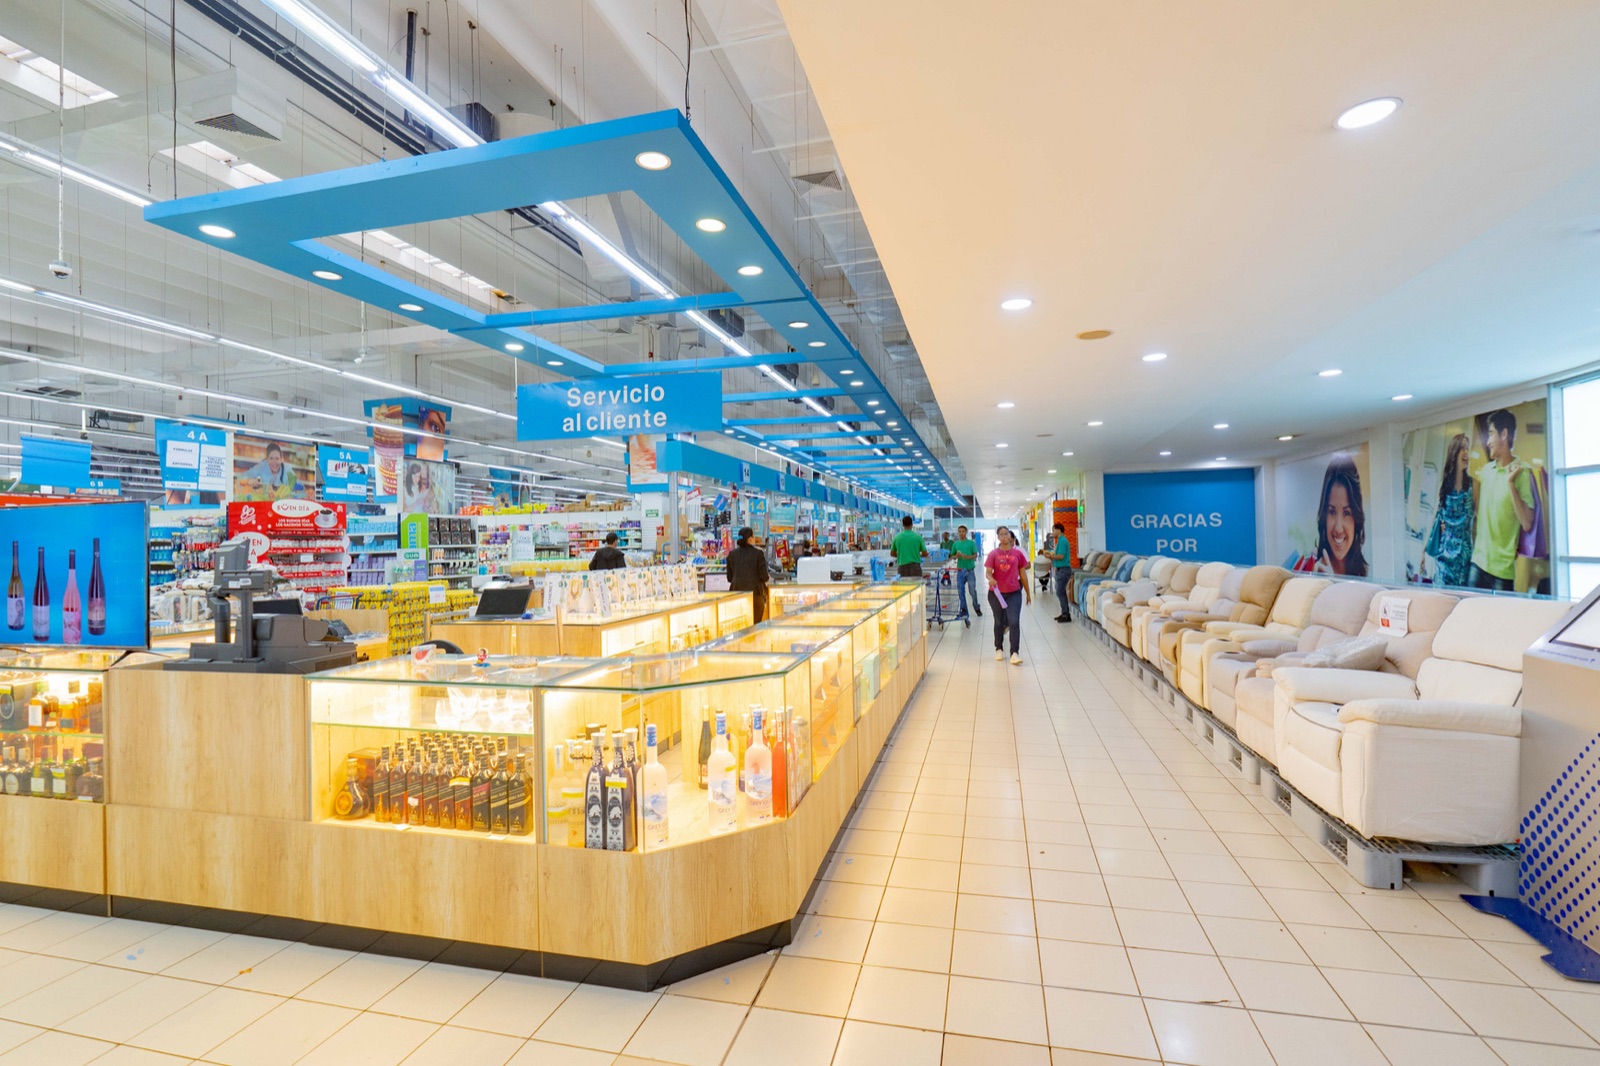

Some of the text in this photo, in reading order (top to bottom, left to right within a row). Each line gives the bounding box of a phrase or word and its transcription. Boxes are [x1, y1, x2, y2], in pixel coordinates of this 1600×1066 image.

[566, 384, 665, 408] Servicio
[562, 409, 667, 432] al cliente
[187, 430, 208, 441] 4 A
[345, 453, 352, 461] A
[743, 466, 750, 478] 14
[750, 500, 765, 510] 14
[812, 510, 824, 519] 12
[1130, 512, 1223, 529] GRACIAS
[1156, 538, 1198, 553] POR
